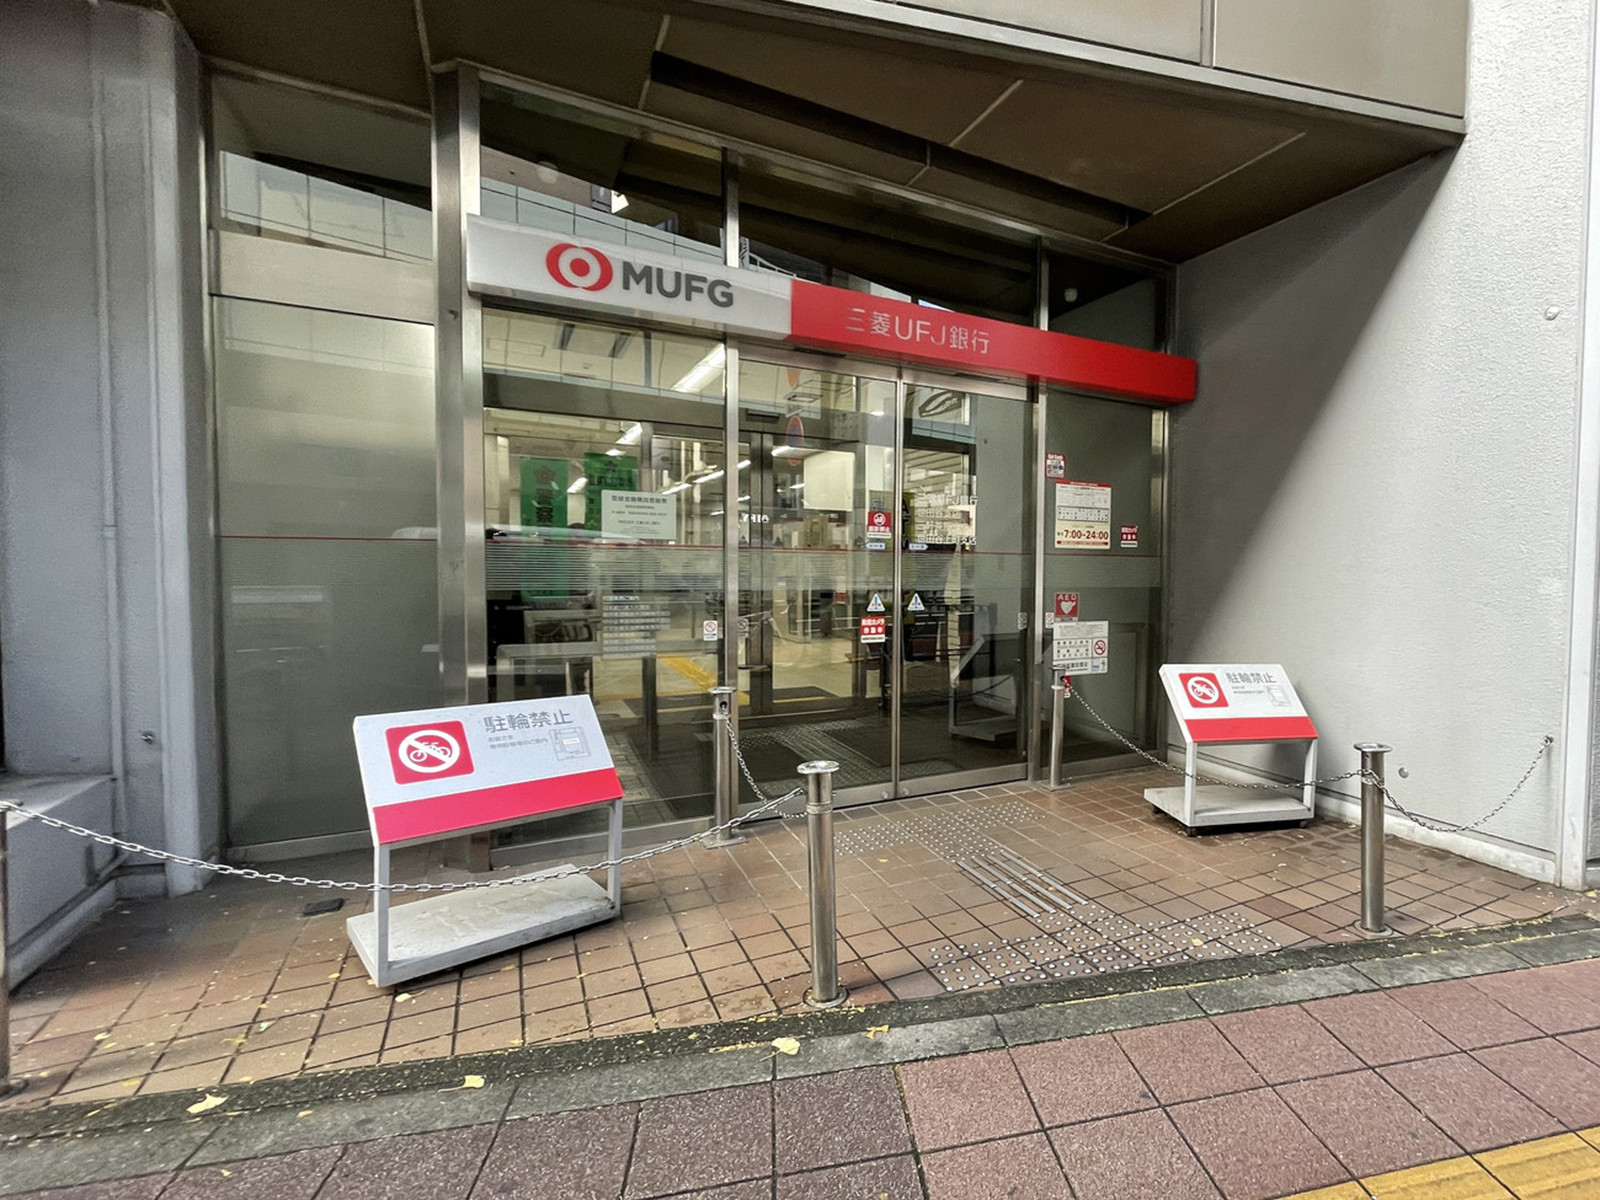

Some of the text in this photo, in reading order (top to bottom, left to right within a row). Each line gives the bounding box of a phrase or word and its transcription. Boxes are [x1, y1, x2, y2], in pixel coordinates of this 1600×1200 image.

[622, 261, 734, 307] MUFG
[845, 306, 990, 355] 三菱UFJ銀行
[1057, 593, 1077, 601] AED
[1225, 671, 1277, 684] 駐輪禁止
[483, 708, 574, 733] 駐輪禁止
